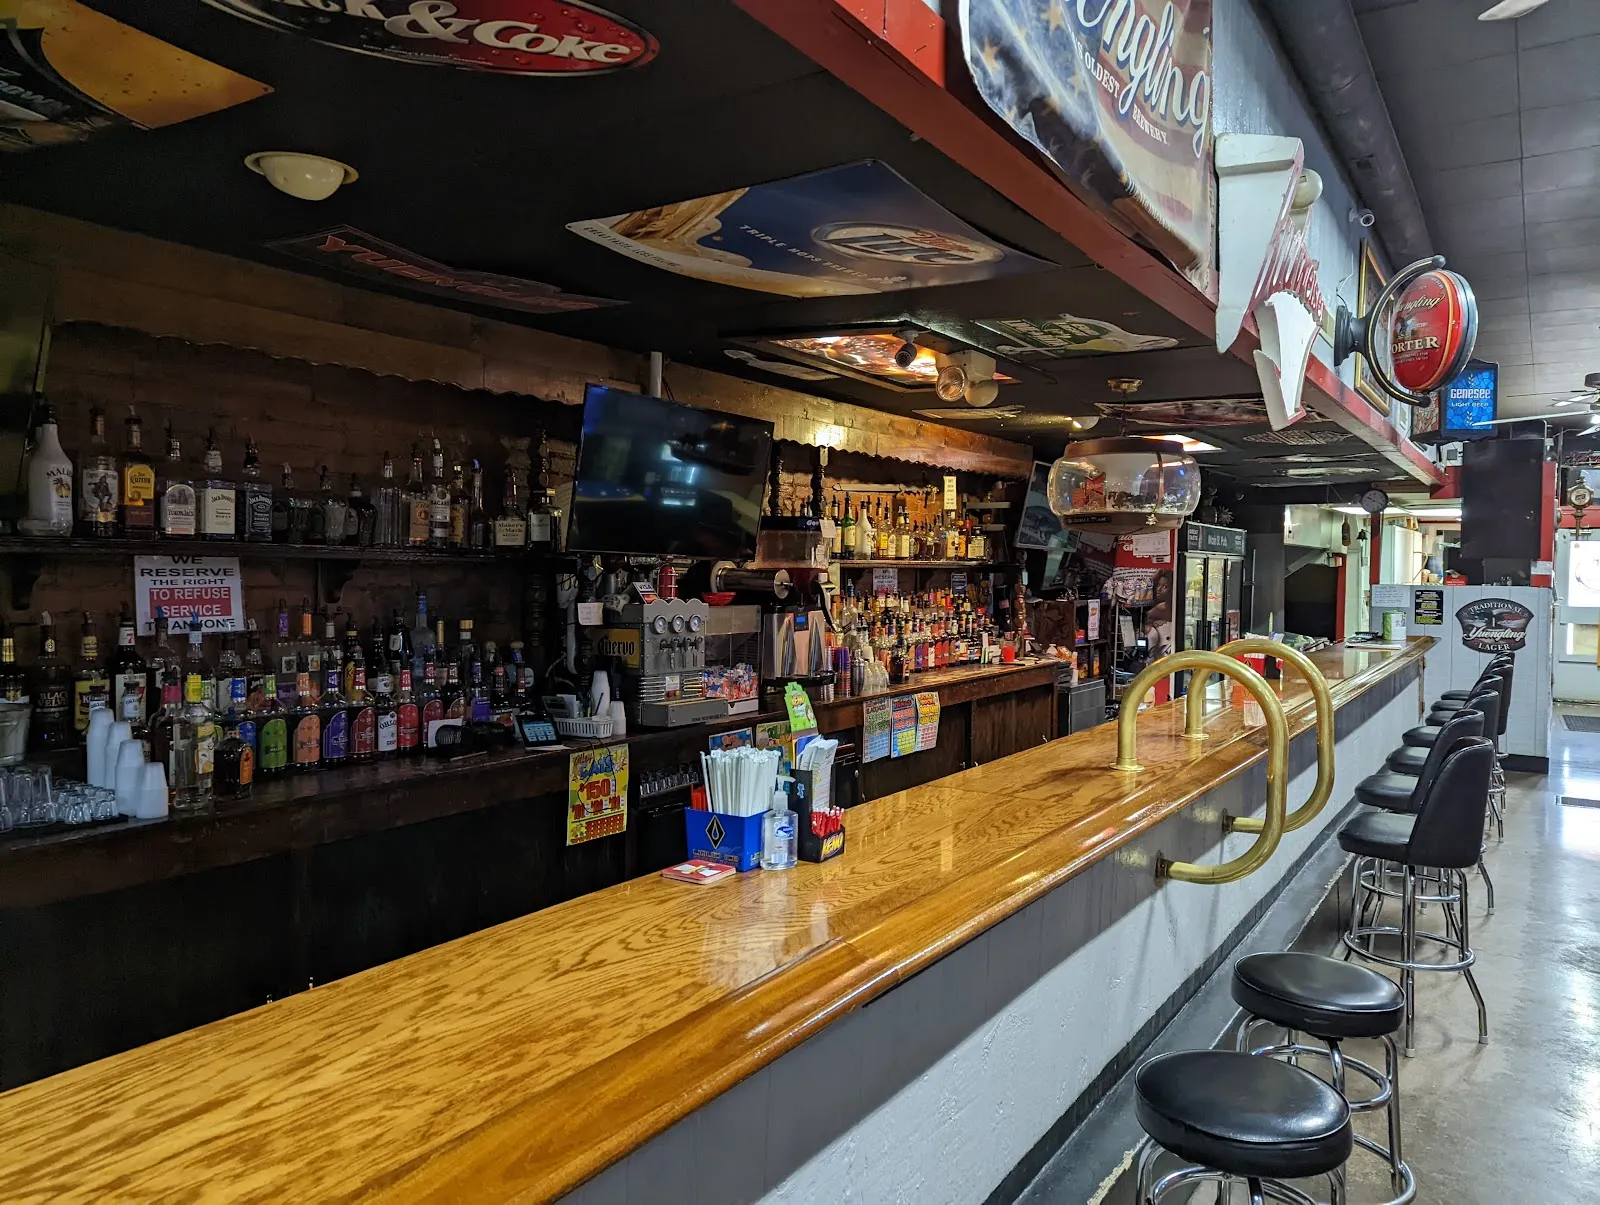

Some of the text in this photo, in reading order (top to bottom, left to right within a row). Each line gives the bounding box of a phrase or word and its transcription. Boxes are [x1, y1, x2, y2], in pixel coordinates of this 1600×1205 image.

[384, 0, 479, 44] &
[473, 19, 631, 64] Coke
[1084, 53, 1121, 99] OLDEST
[1132, 103, 1168, 145] BREWERY
[738, 222, 788, 249] TRIPLE
[172, 555, 203, 564] WE
[140, 567, 235, 577] RESERVE
[150, 578, 226, 586] THE RIGHT
[151, 587, 230, 601] TO REFUSE
[161, 604, 222, 618] SERVICE
[1468, 601, 1524, 614] TRADITIONAL
[1462, 625, 1528, 643] Yuengling
[1478, 642, 1510, 651] LAGER
